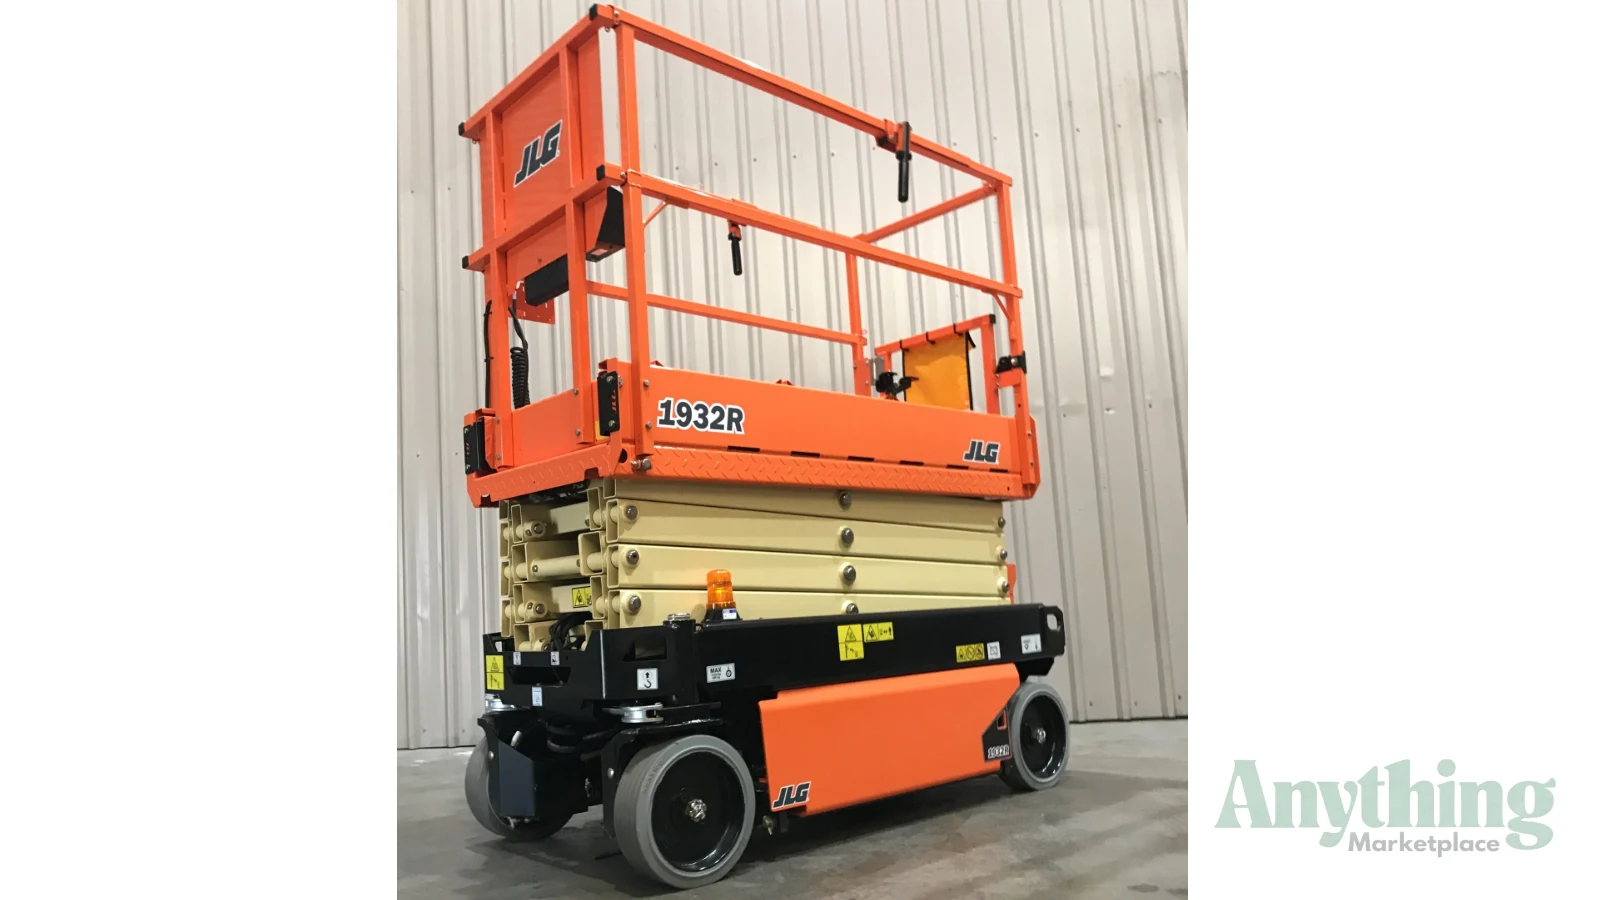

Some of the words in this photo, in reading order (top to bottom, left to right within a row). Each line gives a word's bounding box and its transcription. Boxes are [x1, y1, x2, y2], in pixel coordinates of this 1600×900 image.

[514, 119, 562, 188] JLG
[657, 398, 745, 434] 1932R
[963, 439, 1000, 464] JLG
[772, 781, 811, 809] JLG
